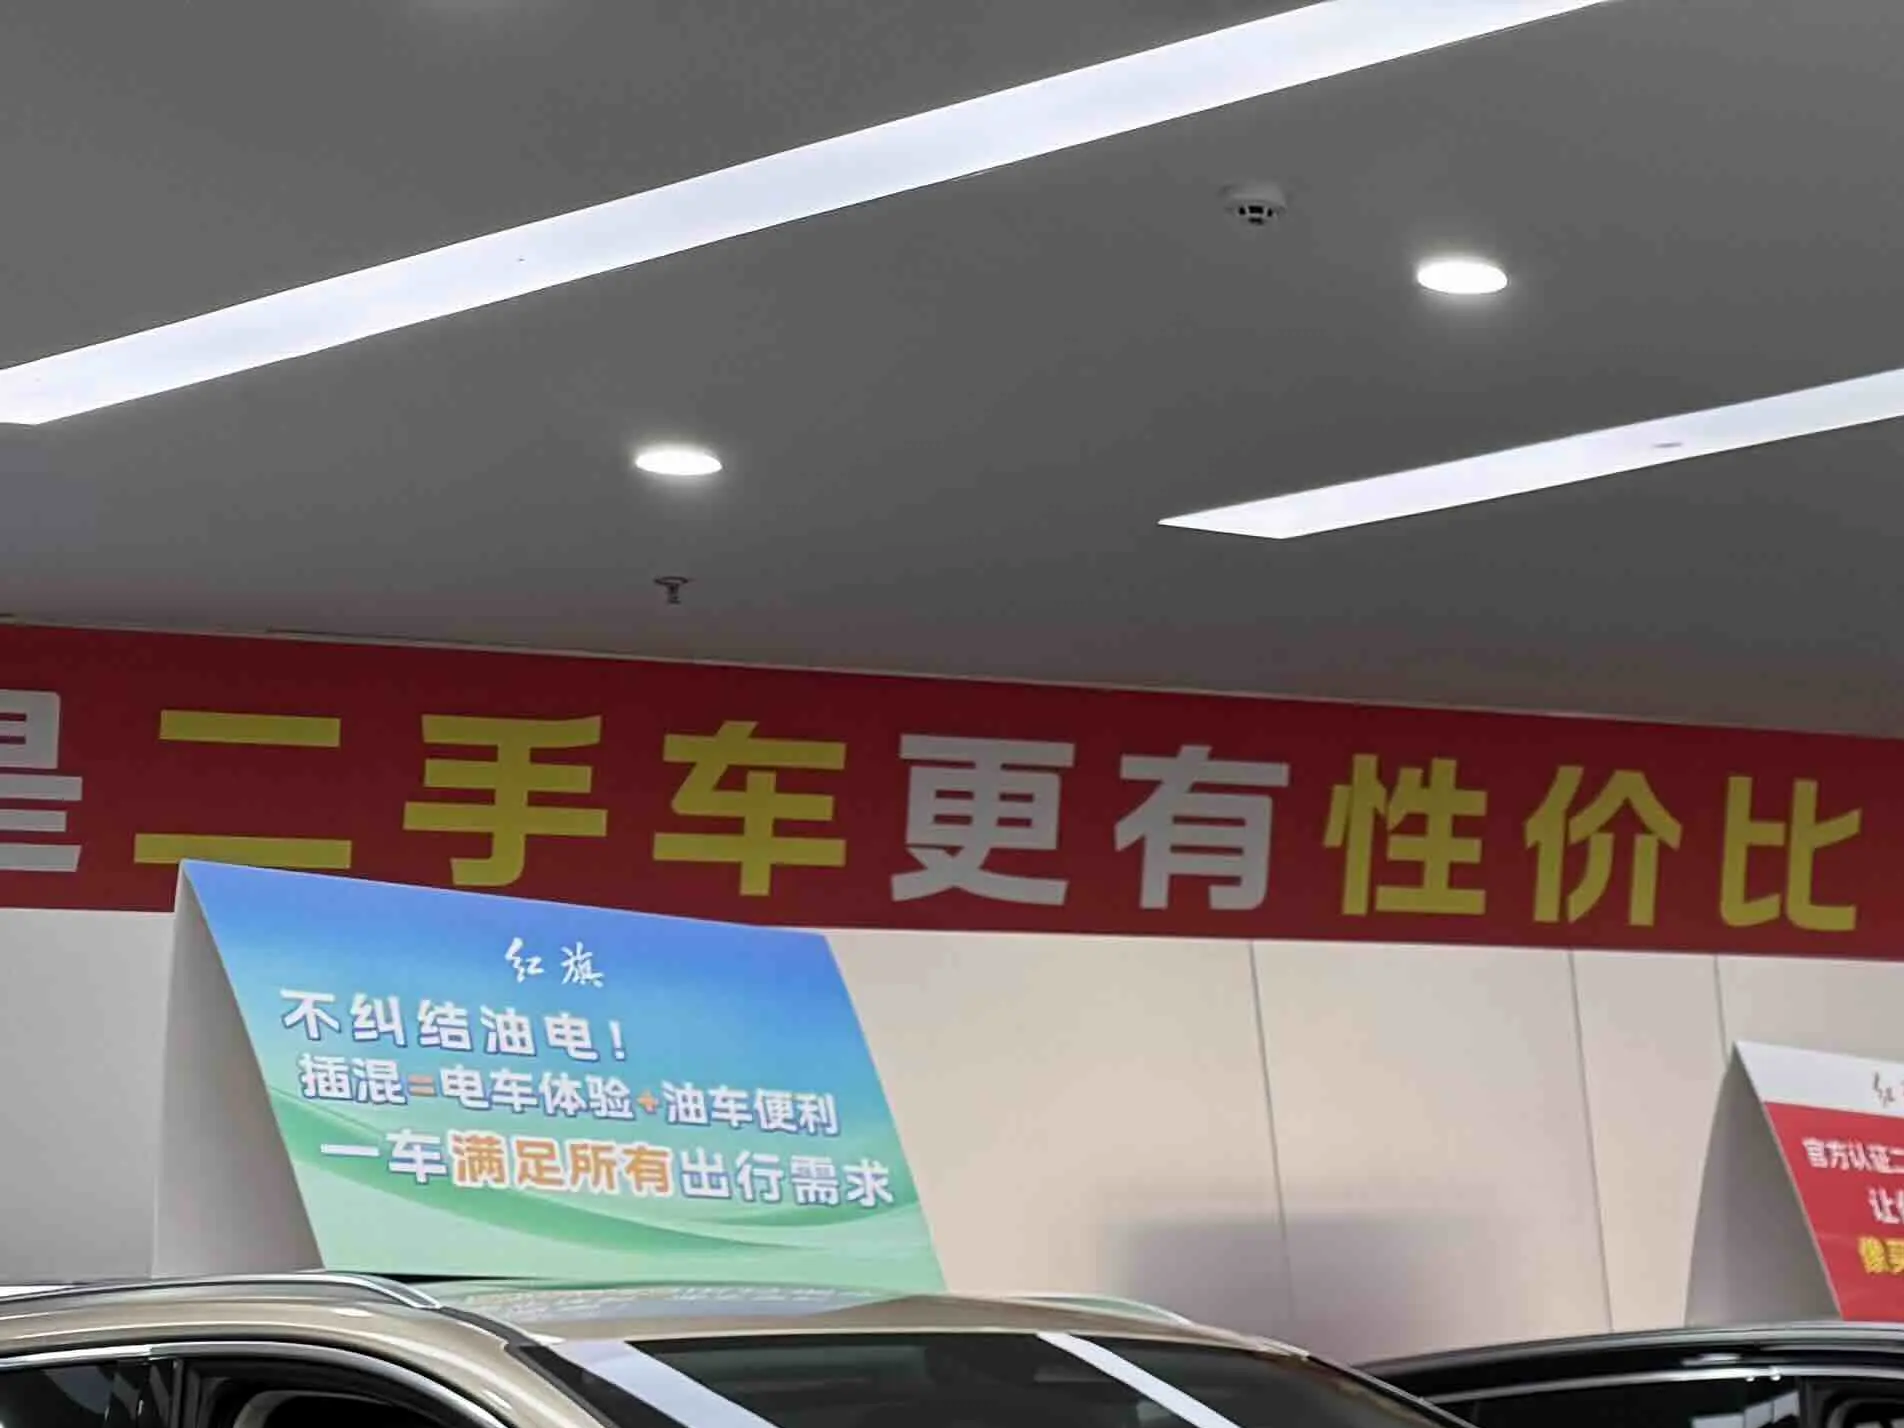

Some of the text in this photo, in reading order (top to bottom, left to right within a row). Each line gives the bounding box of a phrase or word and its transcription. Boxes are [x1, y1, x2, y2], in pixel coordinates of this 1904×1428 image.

[505, 937, 604, 988] 红旗
[320, 1130, 895, 1208] 一车满足所有出行需求
